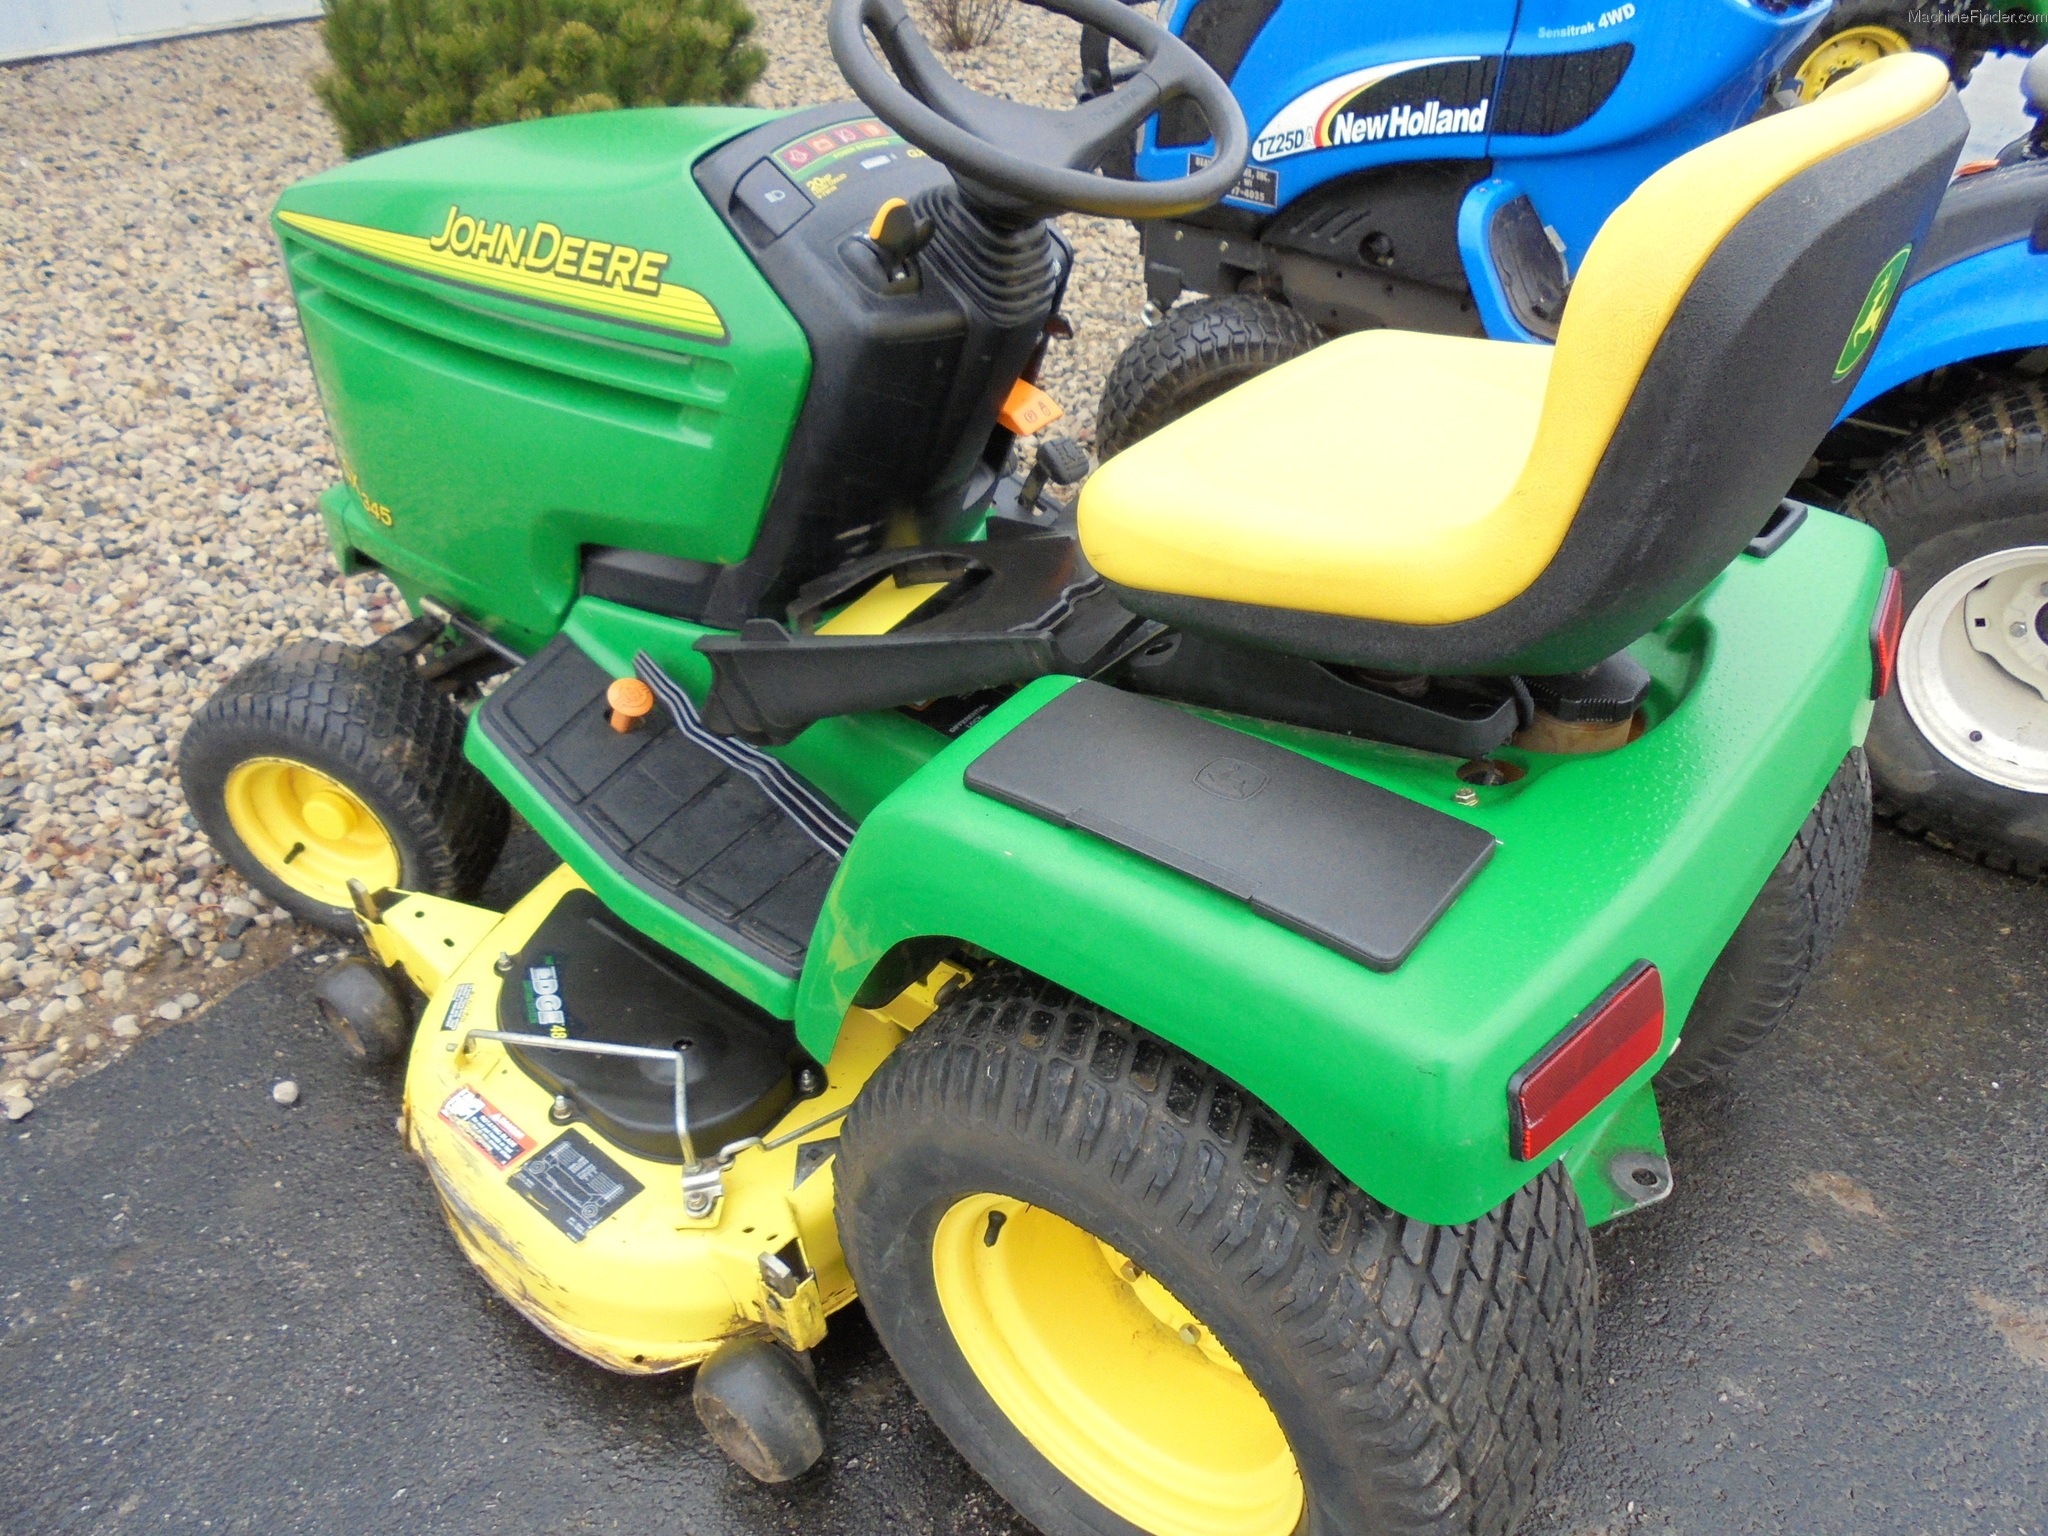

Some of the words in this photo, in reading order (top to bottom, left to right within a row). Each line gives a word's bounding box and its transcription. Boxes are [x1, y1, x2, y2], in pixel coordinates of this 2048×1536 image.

[1538, 21, 1595, 39] Sensitrak
[1598, 3, 1636, 28] 4WD
[1333, 112, 1390, 145] New
[1388, 99, 1489, 138] Holland
[430, 205, 527, 268] JOHN
[524, 221, 671, 297] DEERE
[530, 966, 565, 1025] EDGE
[550, 1025, 568, 1039] 48
